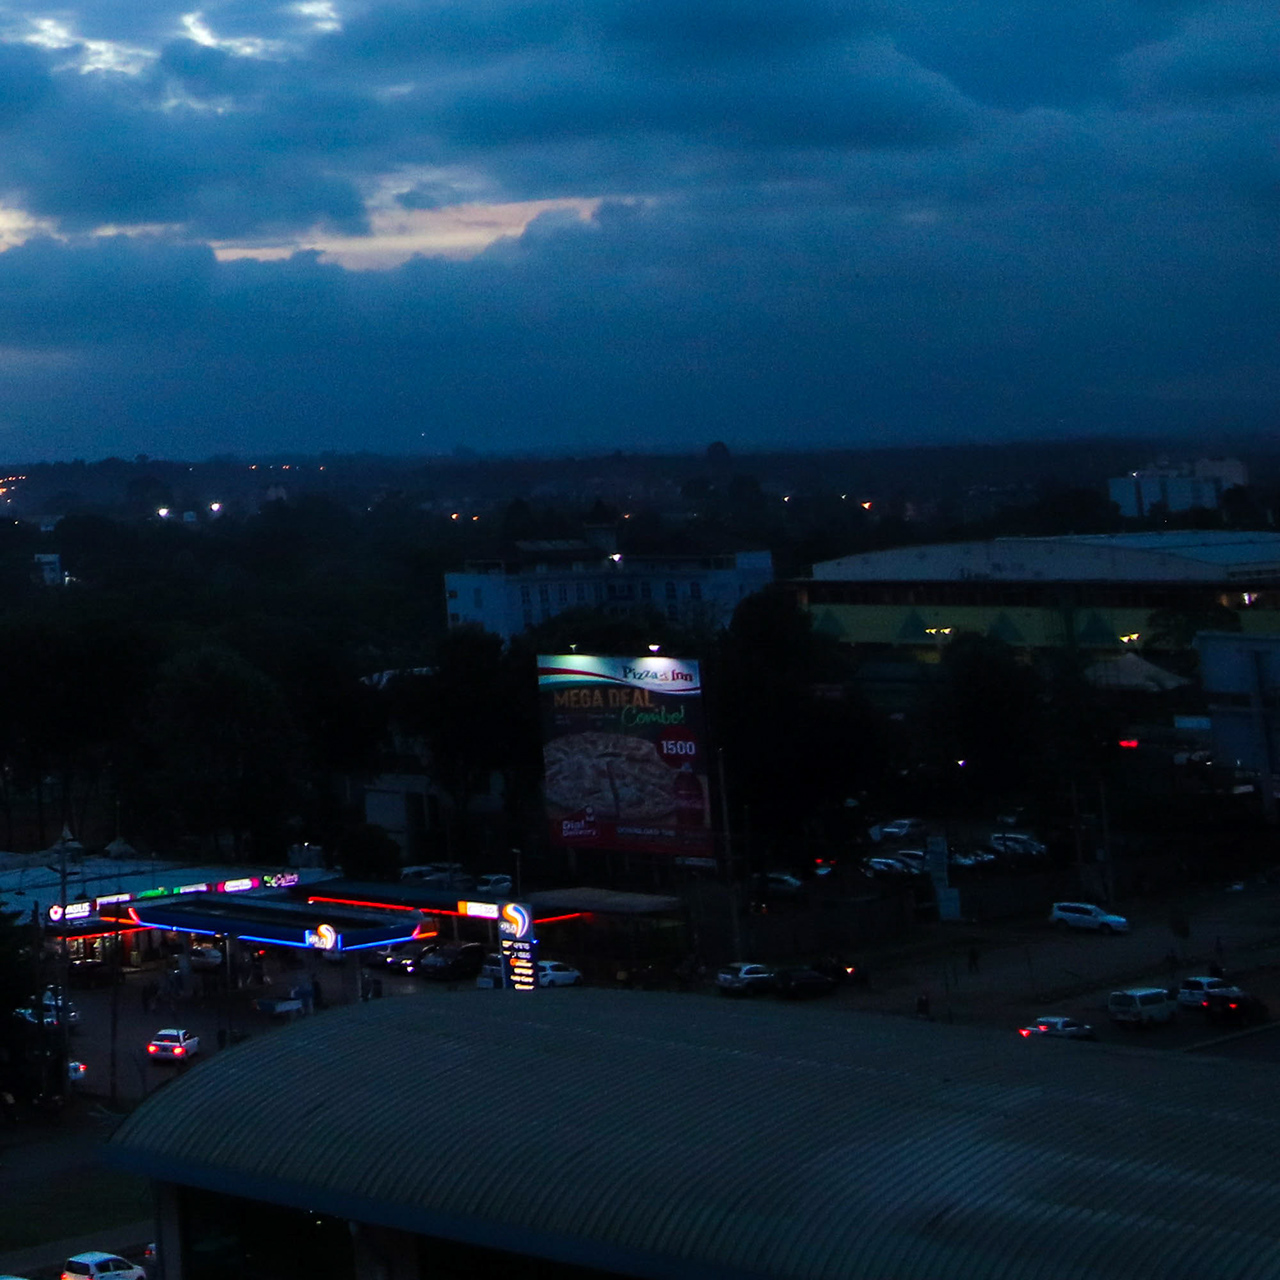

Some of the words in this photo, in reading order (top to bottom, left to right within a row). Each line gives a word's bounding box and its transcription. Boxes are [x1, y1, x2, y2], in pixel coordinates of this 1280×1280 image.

[623, 665, 657, 680] Pizza
[671, 669, 693, 682] Inn
[553, 689, 603, 708] MEGA
[609, 689, 654, 708] DEAL
[621, 705, 685, 727] Combo!
[661, 740, 696, 755] 1500
